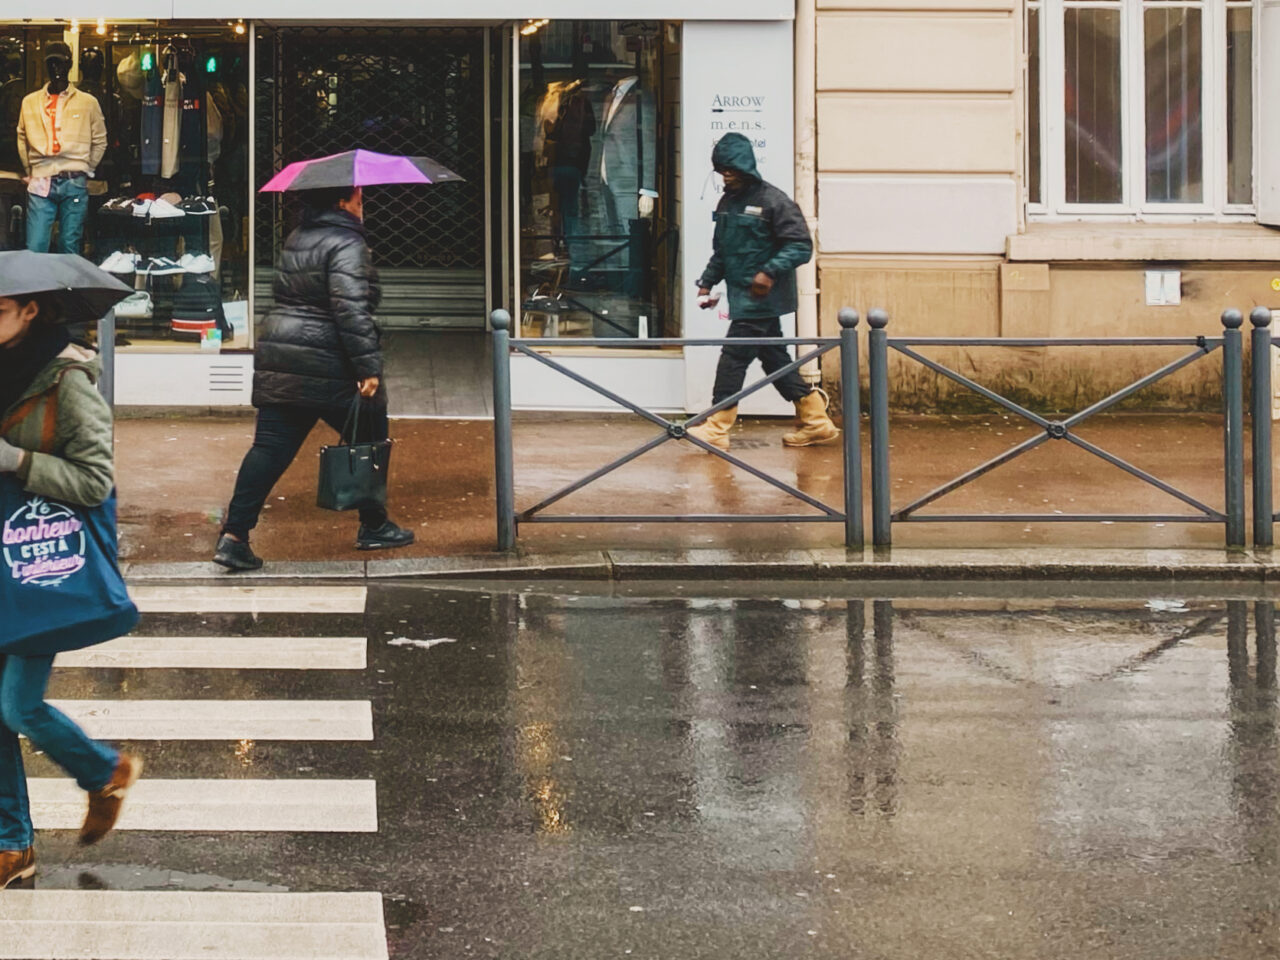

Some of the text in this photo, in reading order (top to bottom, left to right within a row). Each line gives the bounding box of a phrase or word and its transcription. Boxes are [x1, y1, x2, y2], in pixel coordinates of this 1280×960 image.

[710, 120, 767, 130] m.e.n.s.
[2, 515, 83, 545] bonheur
[21, 536, 70, 559] C'EST À
